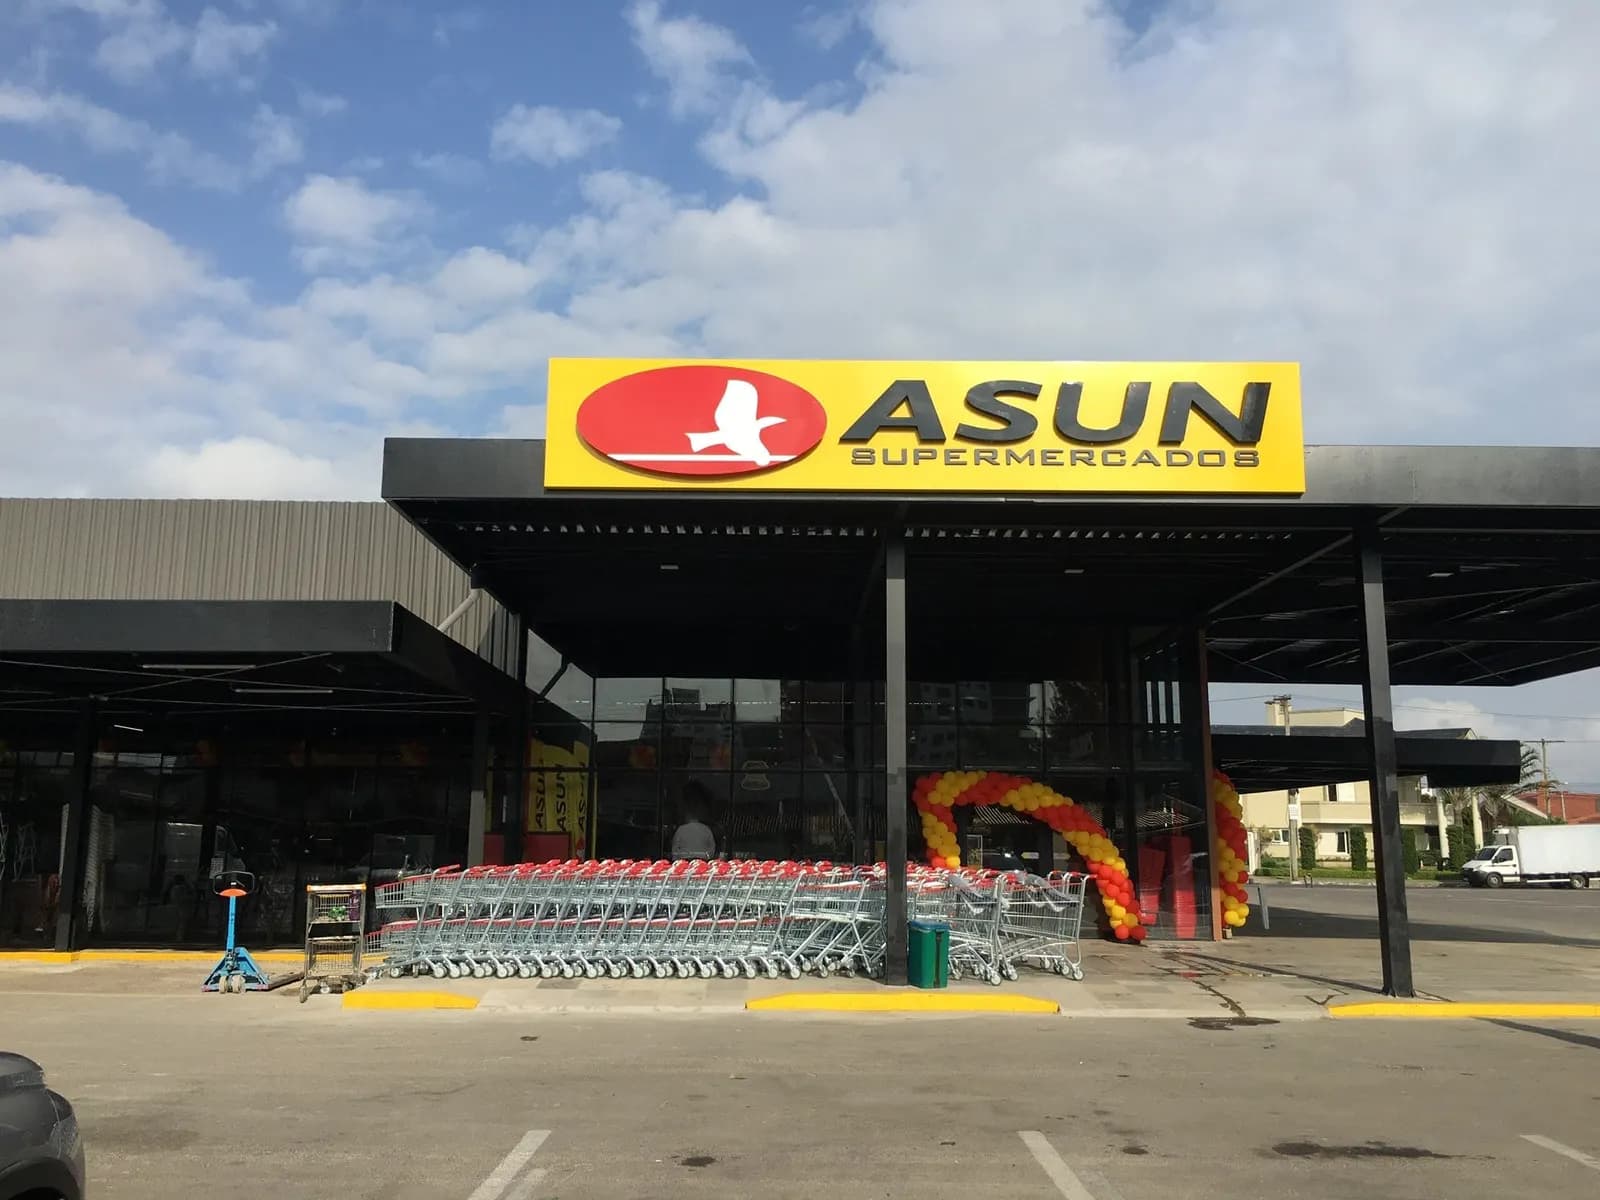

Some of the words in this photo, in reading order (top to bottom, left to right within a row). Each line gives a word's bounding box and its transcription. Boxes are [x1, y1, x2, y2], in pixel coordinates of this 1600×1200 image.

[839, 379, 1272, 446] ASUN
[851, 447, 1260, 467] SUPERMERCADOS
[556, 763, 567, 832] ASUN
